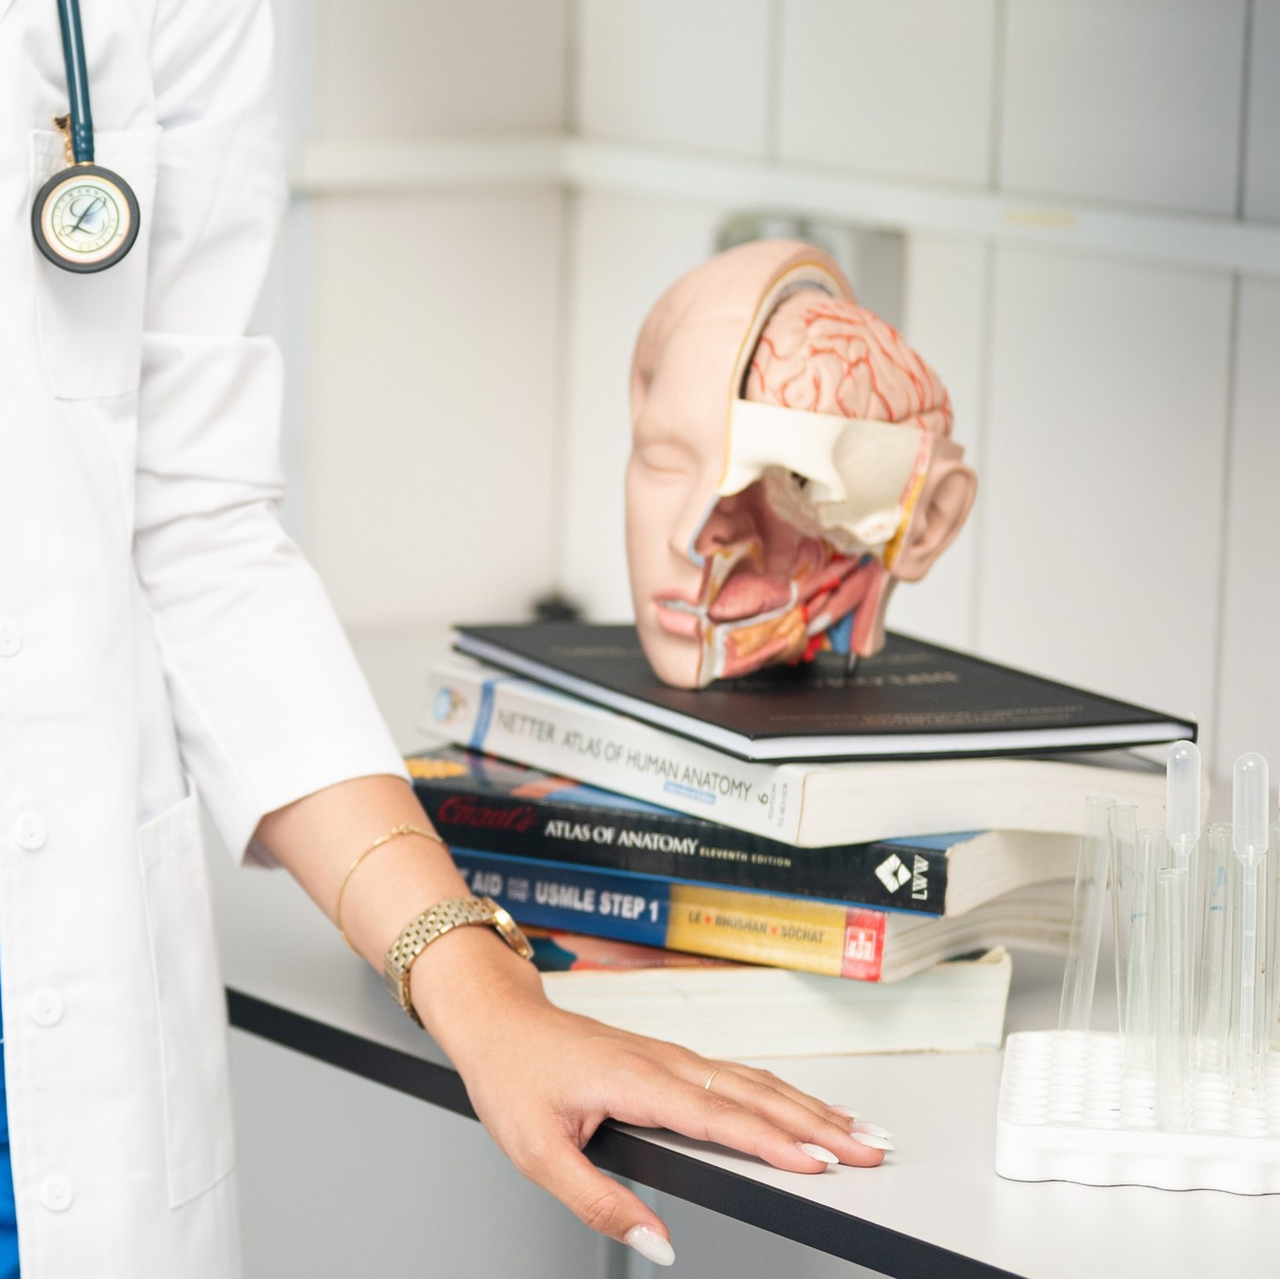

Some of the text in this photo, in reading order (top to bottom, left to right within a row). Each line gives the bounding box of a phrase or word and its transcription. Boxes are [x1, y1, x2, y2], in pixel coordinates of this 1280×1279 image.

[496, 709, 554, 743] NETTER
[561, 731, 602, 759] ATLAS
[604, 741, 625, 765] OF
[626, 748, 680, 779] HUMAN
[681, 763, 753, 802] ANATOMY
[757, 792, 769, 805] 6
[544, 819, 792, 868] ATLAS OF ANATOMY ELEVENTH EDITION
[471, 870, 504, 897] AID
[911, 854, 930, 900] LWW
[535, 880, 659, 922] USMLE STEP 1
